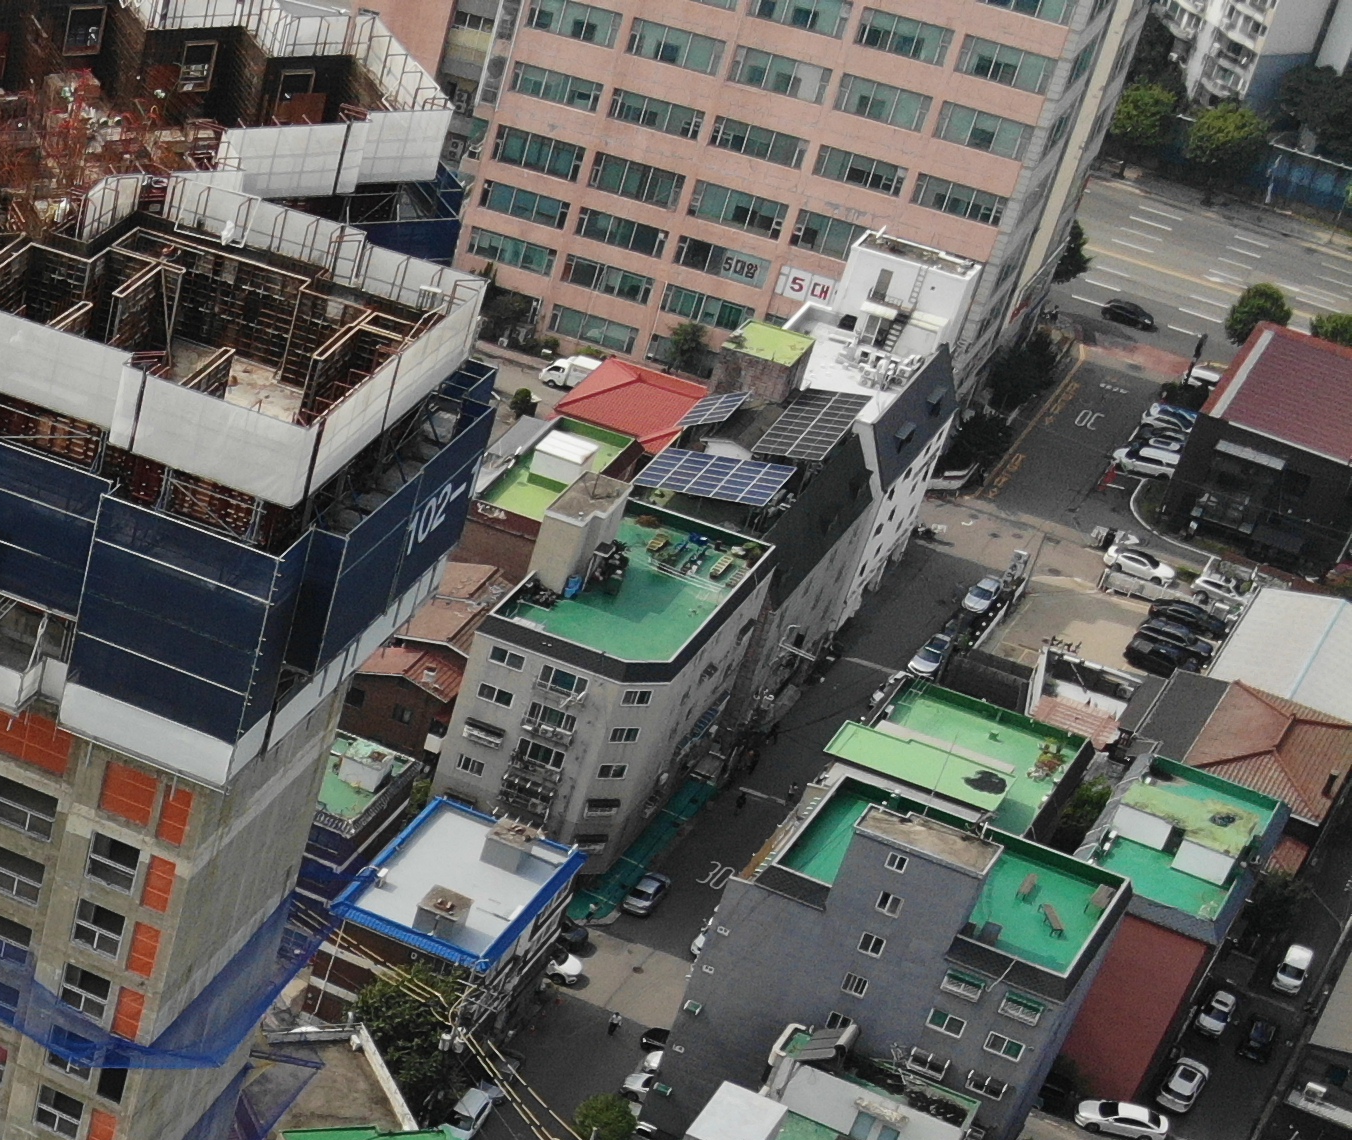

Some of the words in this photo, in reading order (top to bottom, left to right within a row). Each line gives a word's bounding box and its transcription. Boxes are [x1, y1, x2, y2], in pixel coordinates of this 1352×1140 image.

[789, 276, 837, 301] 5대
[406, 454, 484, 556] 102-1
[696, 861, 736, 890] 30
